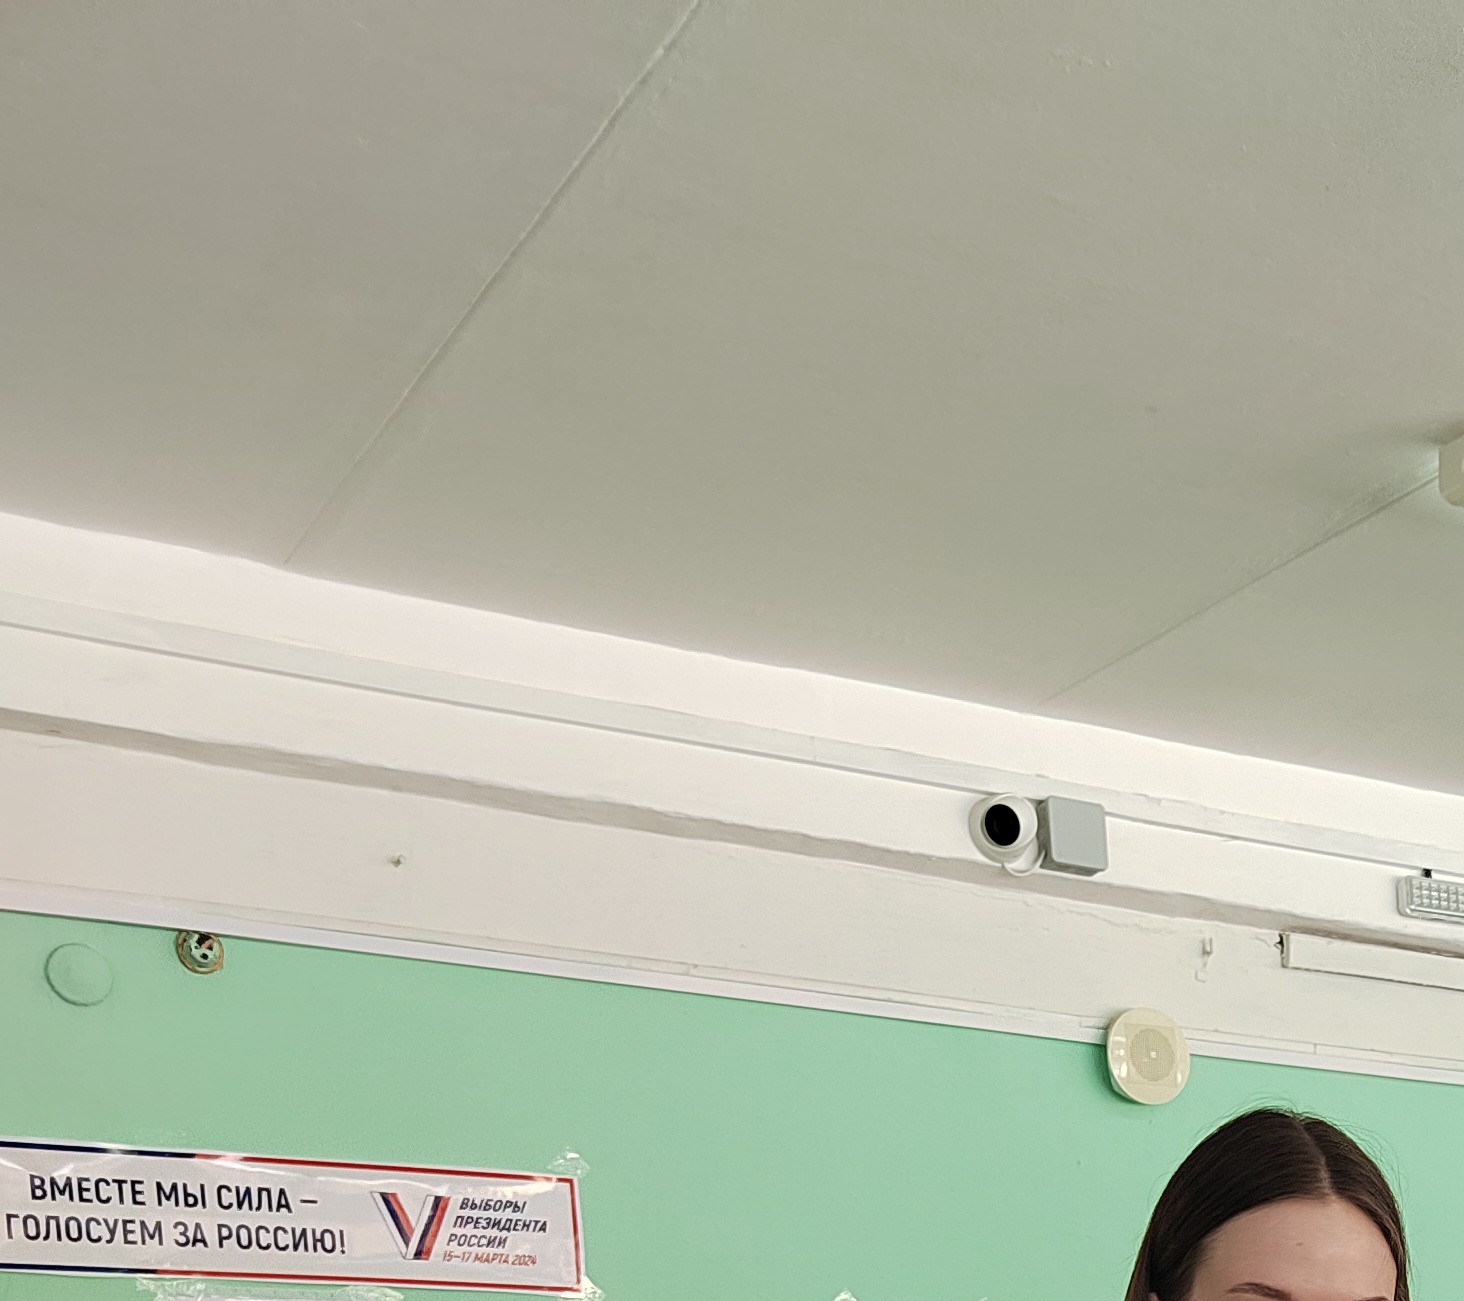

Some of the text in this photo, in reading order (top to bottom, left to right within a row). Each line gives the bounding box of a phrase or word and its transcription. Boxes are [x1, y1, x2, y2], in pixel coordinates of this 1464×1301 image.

[29, 1174, 147, 1206] ВМЕСТЕ
[156, 1181, 207, 1209] МЫ
[216, 1184, 293, 1213] СИЛА
[459, 1197, 527, 1214] ВЫБОРЫ
[453, 1215, 548, 1233] ПРЕЗИДЕНТА
[5, 1212, 346, 1254] ГОЛОСУЕМ ЗА РОССИЮ!
[447, 1233, 508, 1249] РОССИИ
[474, 1252, 509, 1265] МАРТА
[511, 1254, 537, 1266] 2024
